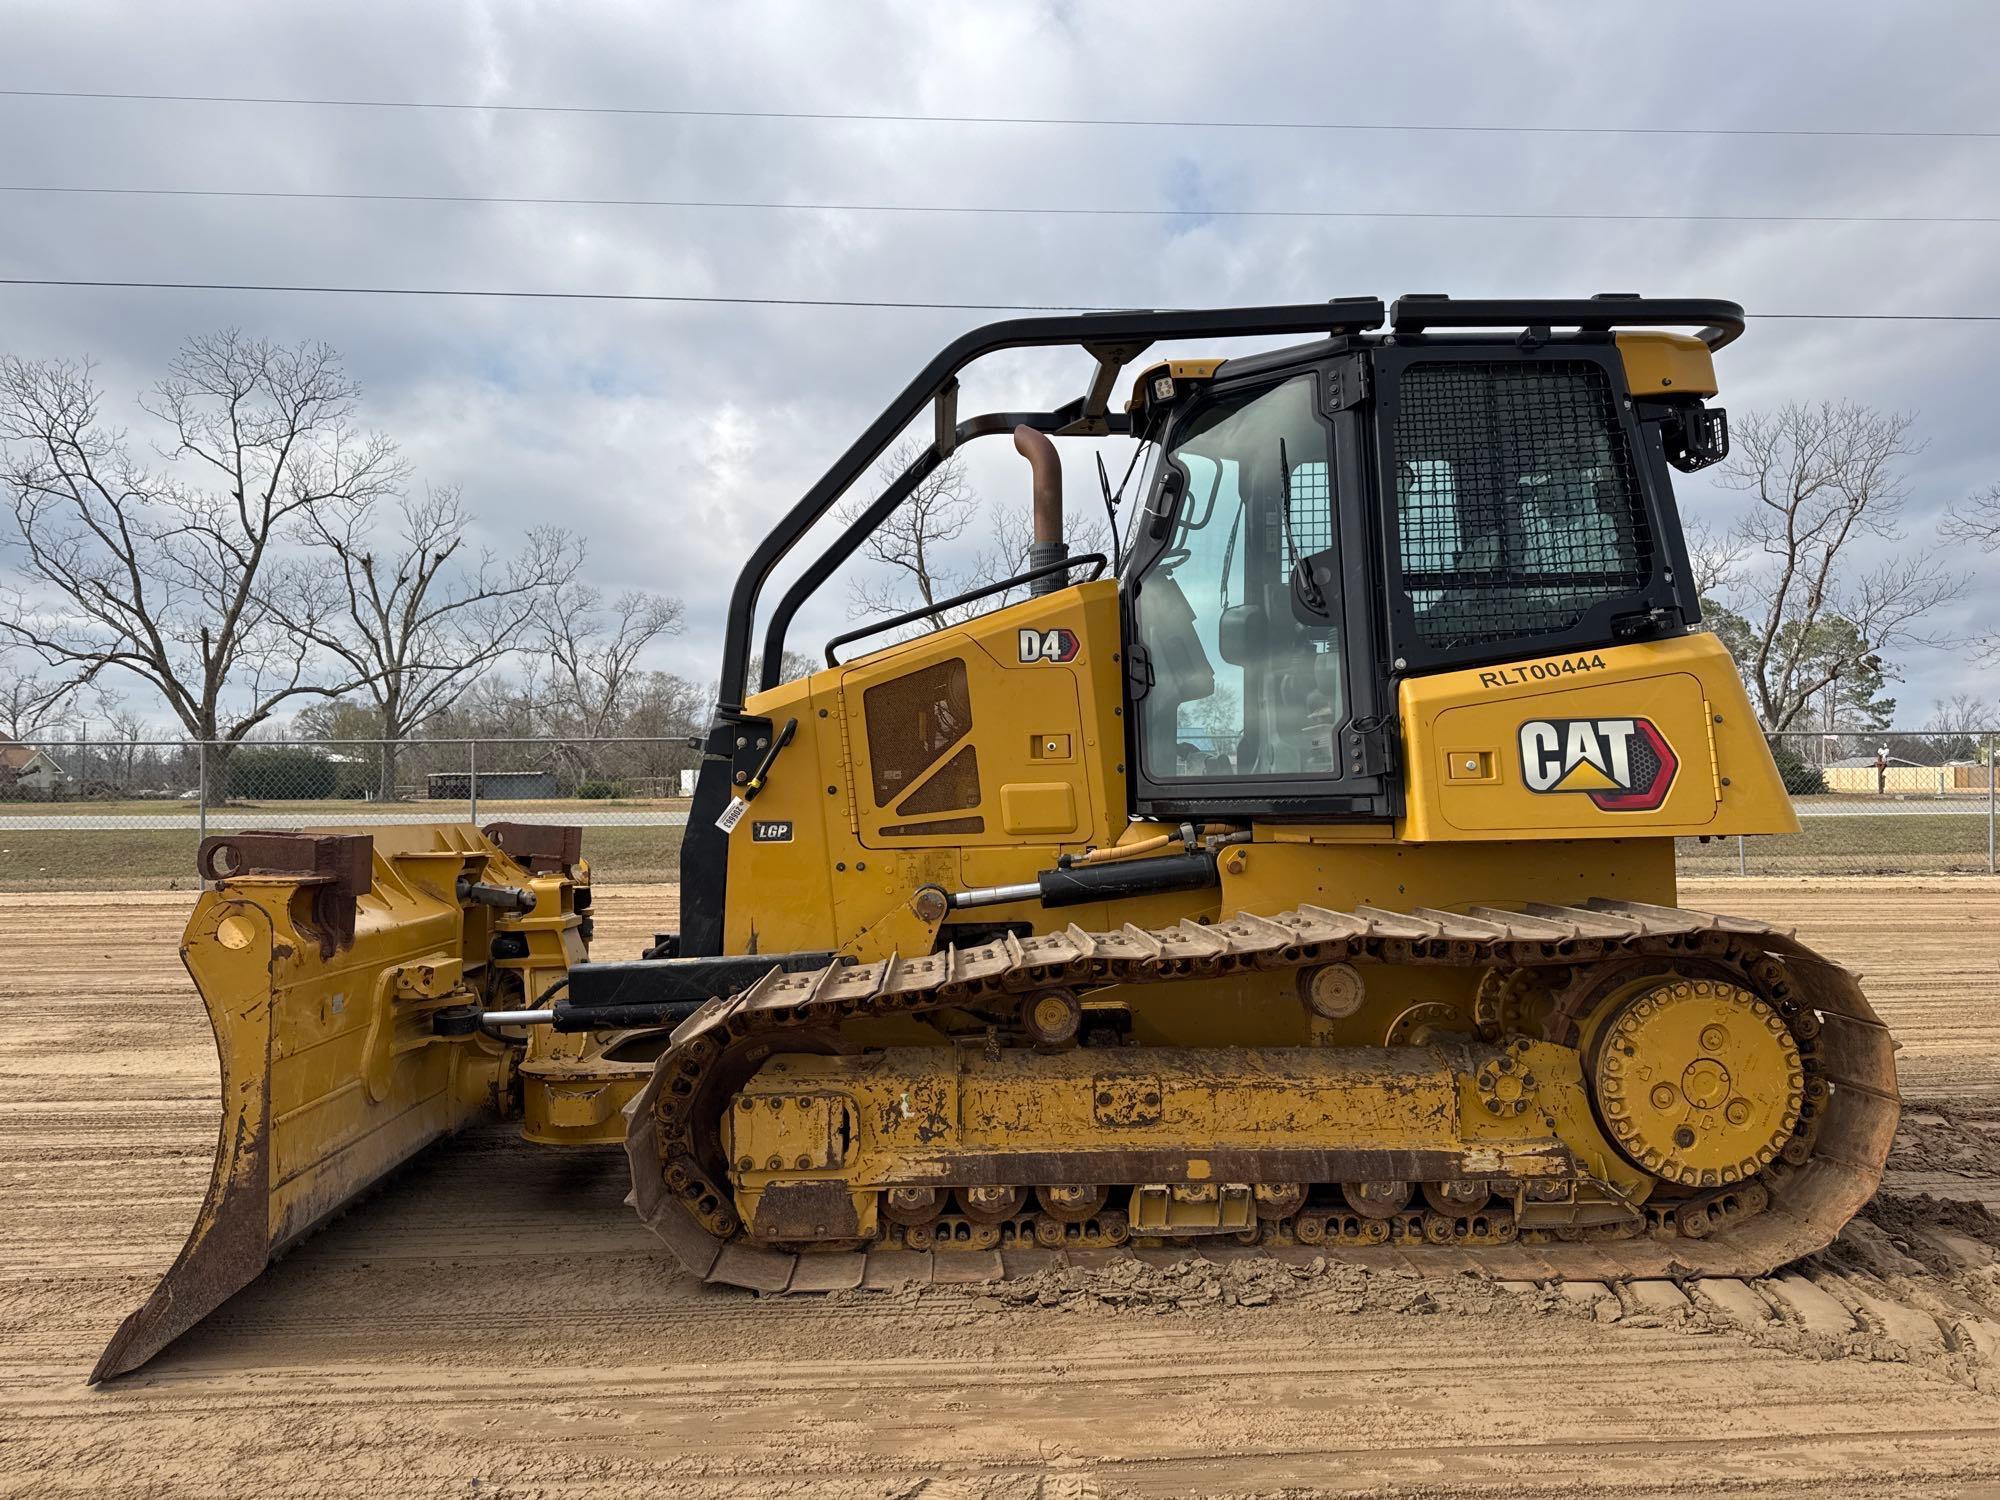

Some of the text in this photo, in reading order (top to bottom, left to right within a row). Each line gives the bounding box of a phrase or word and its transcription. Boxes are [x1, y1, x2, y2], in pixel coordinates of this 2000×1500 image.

[1020, 630, 1061, 661] D4
[1479, 655, 1606, 689] RLT00444
[1520, 721, 1635, 790] CAT
[759, 825, 788, 838] LGP
